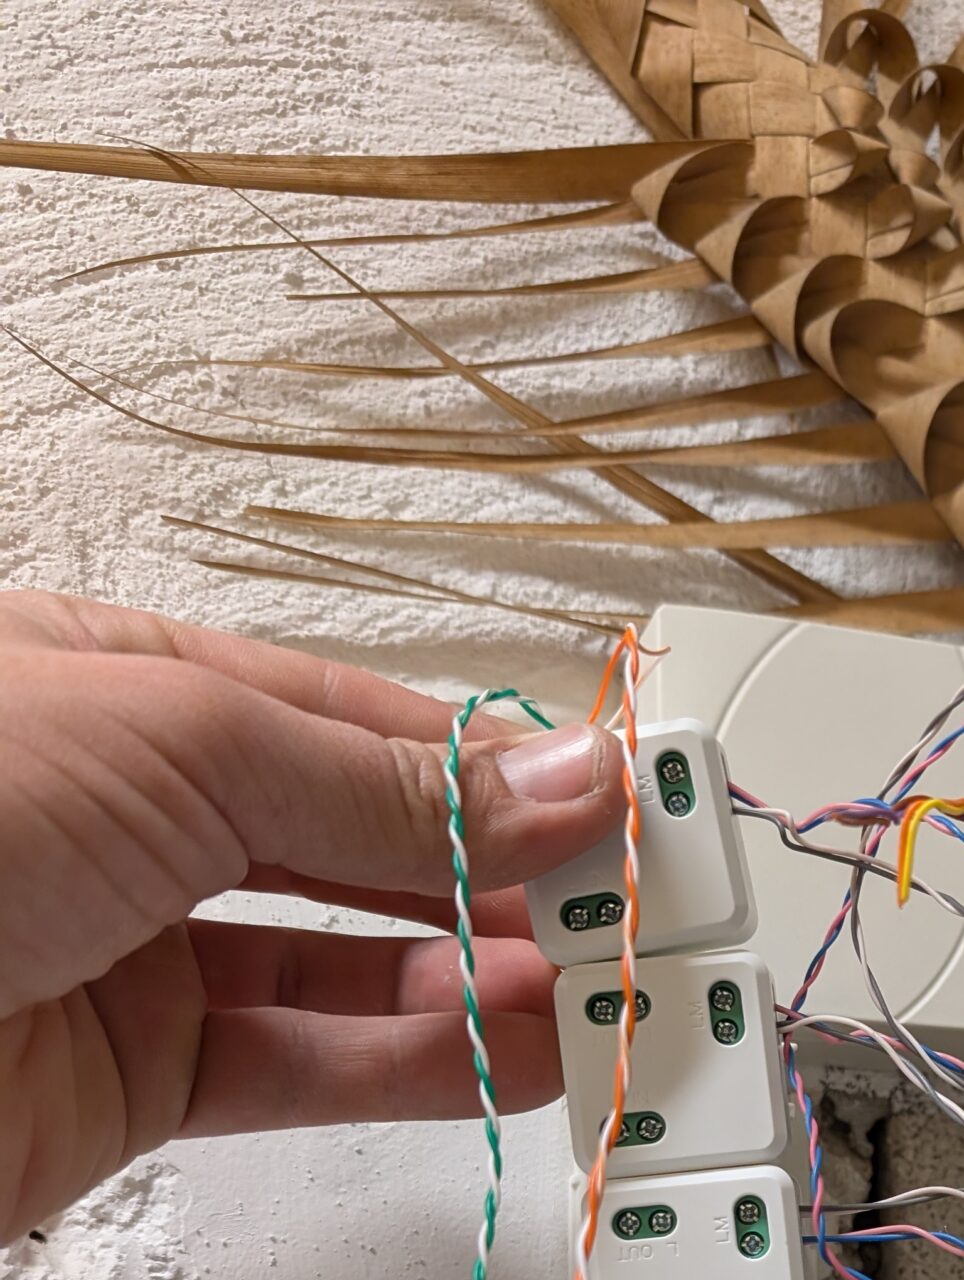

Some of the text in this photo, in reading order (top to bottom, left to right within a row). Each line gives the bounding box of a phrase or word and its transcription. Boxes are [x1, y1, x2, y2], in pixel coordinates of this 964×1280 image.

[688, 1001, 705, 1030] LM
[713, 1215, 731, 1245] LM
[616, 1246, 655, 1263] OUT
